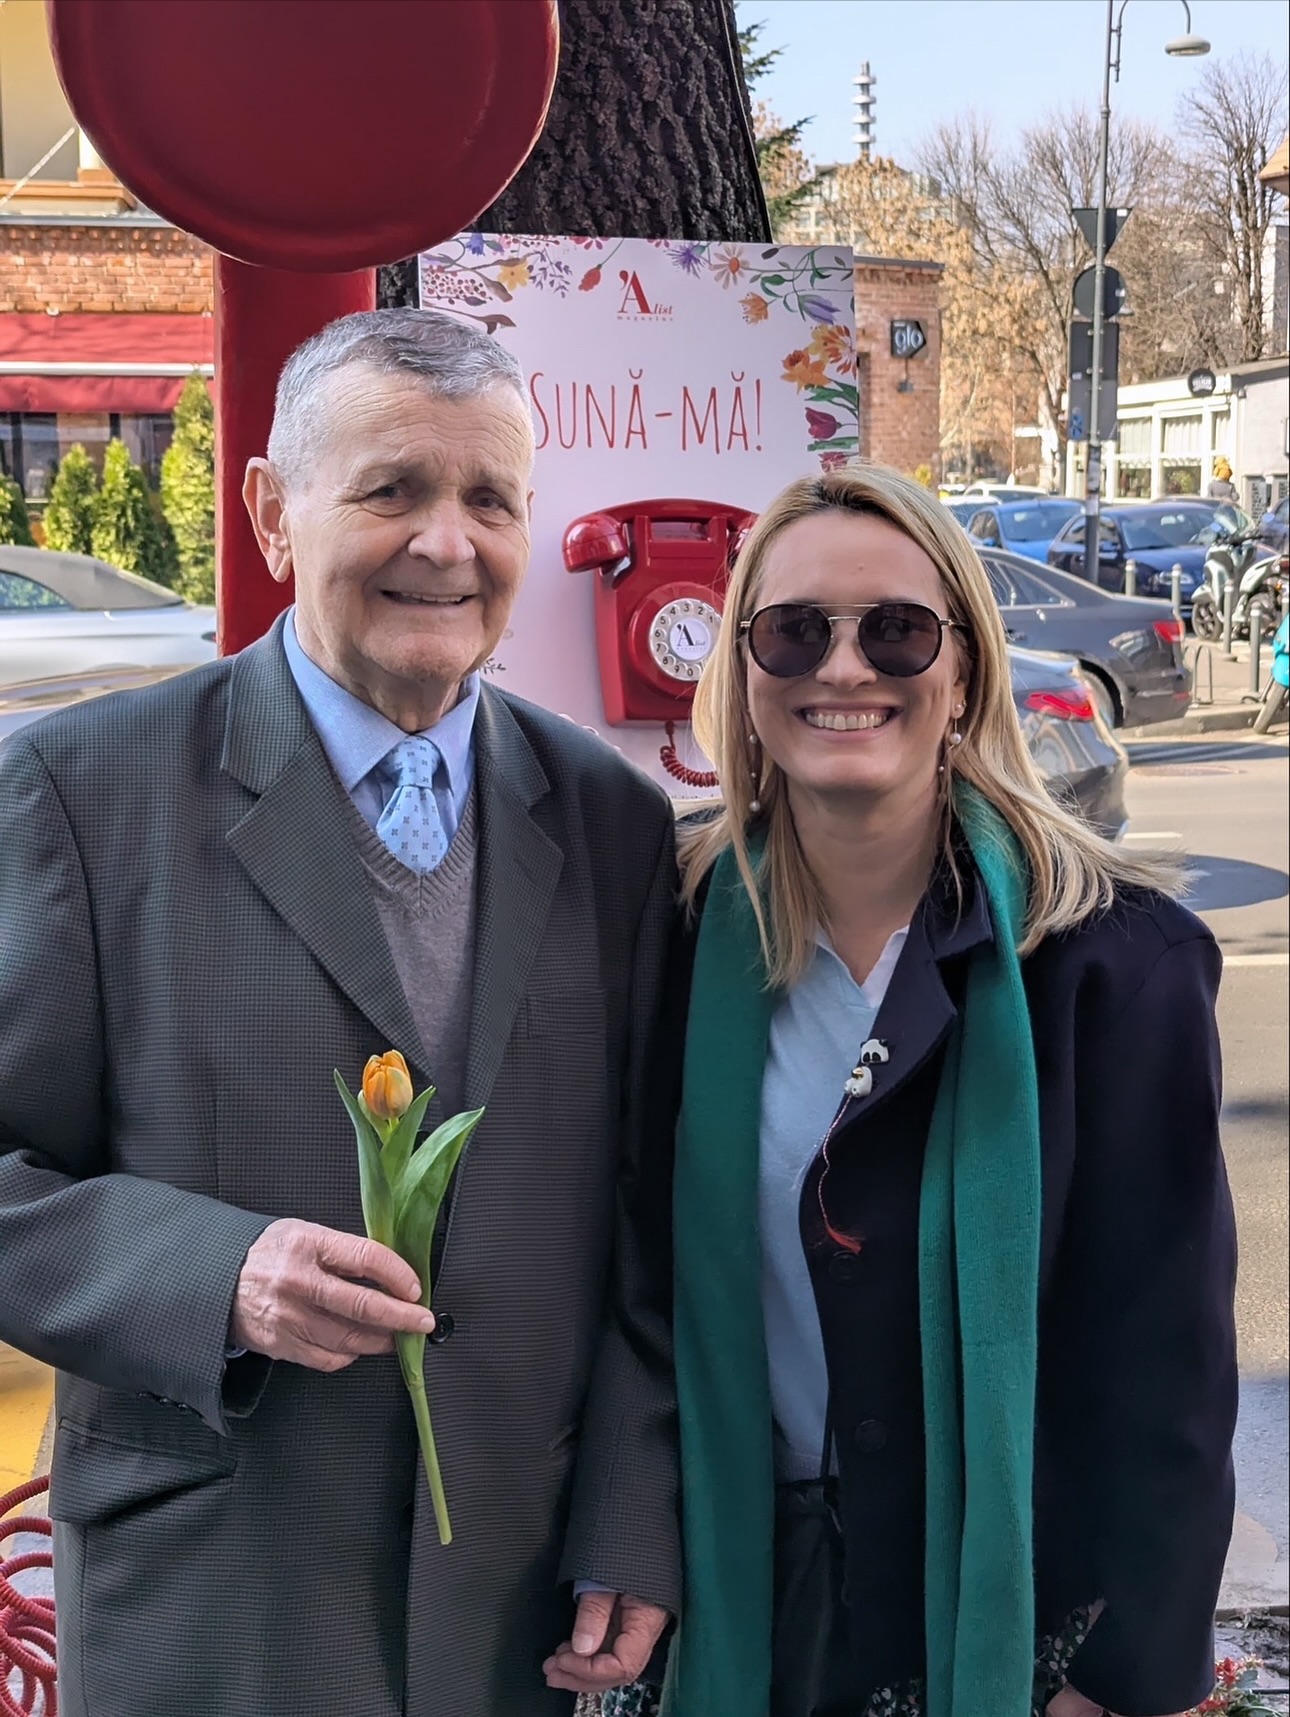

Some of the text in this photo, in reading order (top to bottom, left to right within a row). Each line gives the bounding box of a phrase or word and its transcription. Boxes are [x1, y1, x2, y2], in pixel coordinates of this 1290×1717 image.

[530, 368, 762, 455] SUNĂ-MĂ!
[670, 606, 676, 615] 4
[683, 603, 690, 612] 3
[698, 606, 704, 615] 2
[660, 615, 666, 625] 5
[709, 615, 713, 623] 1
[654, 629, 661, 638] 6
[662, 656, 668, 665] 8
[687, 668, 693, 677] 0
